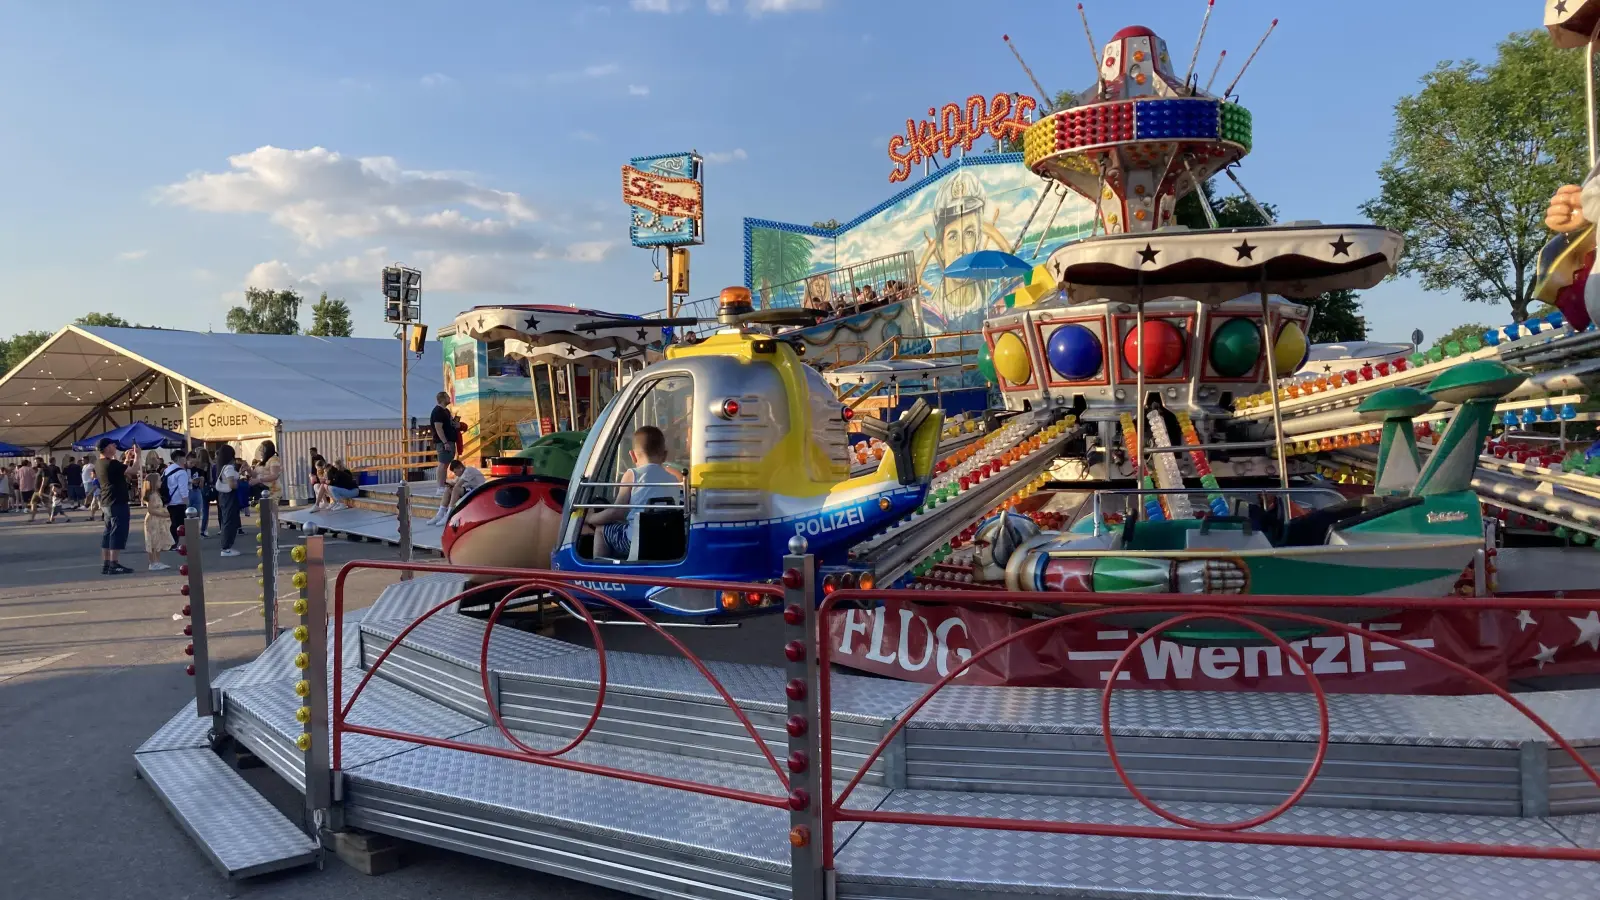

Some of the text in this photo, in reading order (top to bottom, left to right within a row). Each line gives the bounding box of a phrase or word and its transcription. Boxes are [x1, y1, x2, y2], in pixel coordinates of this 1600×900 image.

[162, 417, 205, 431] FESTELT
[794, 506, 865, 536] POLIZEI
[838, 606, 972, 679] FLUG
